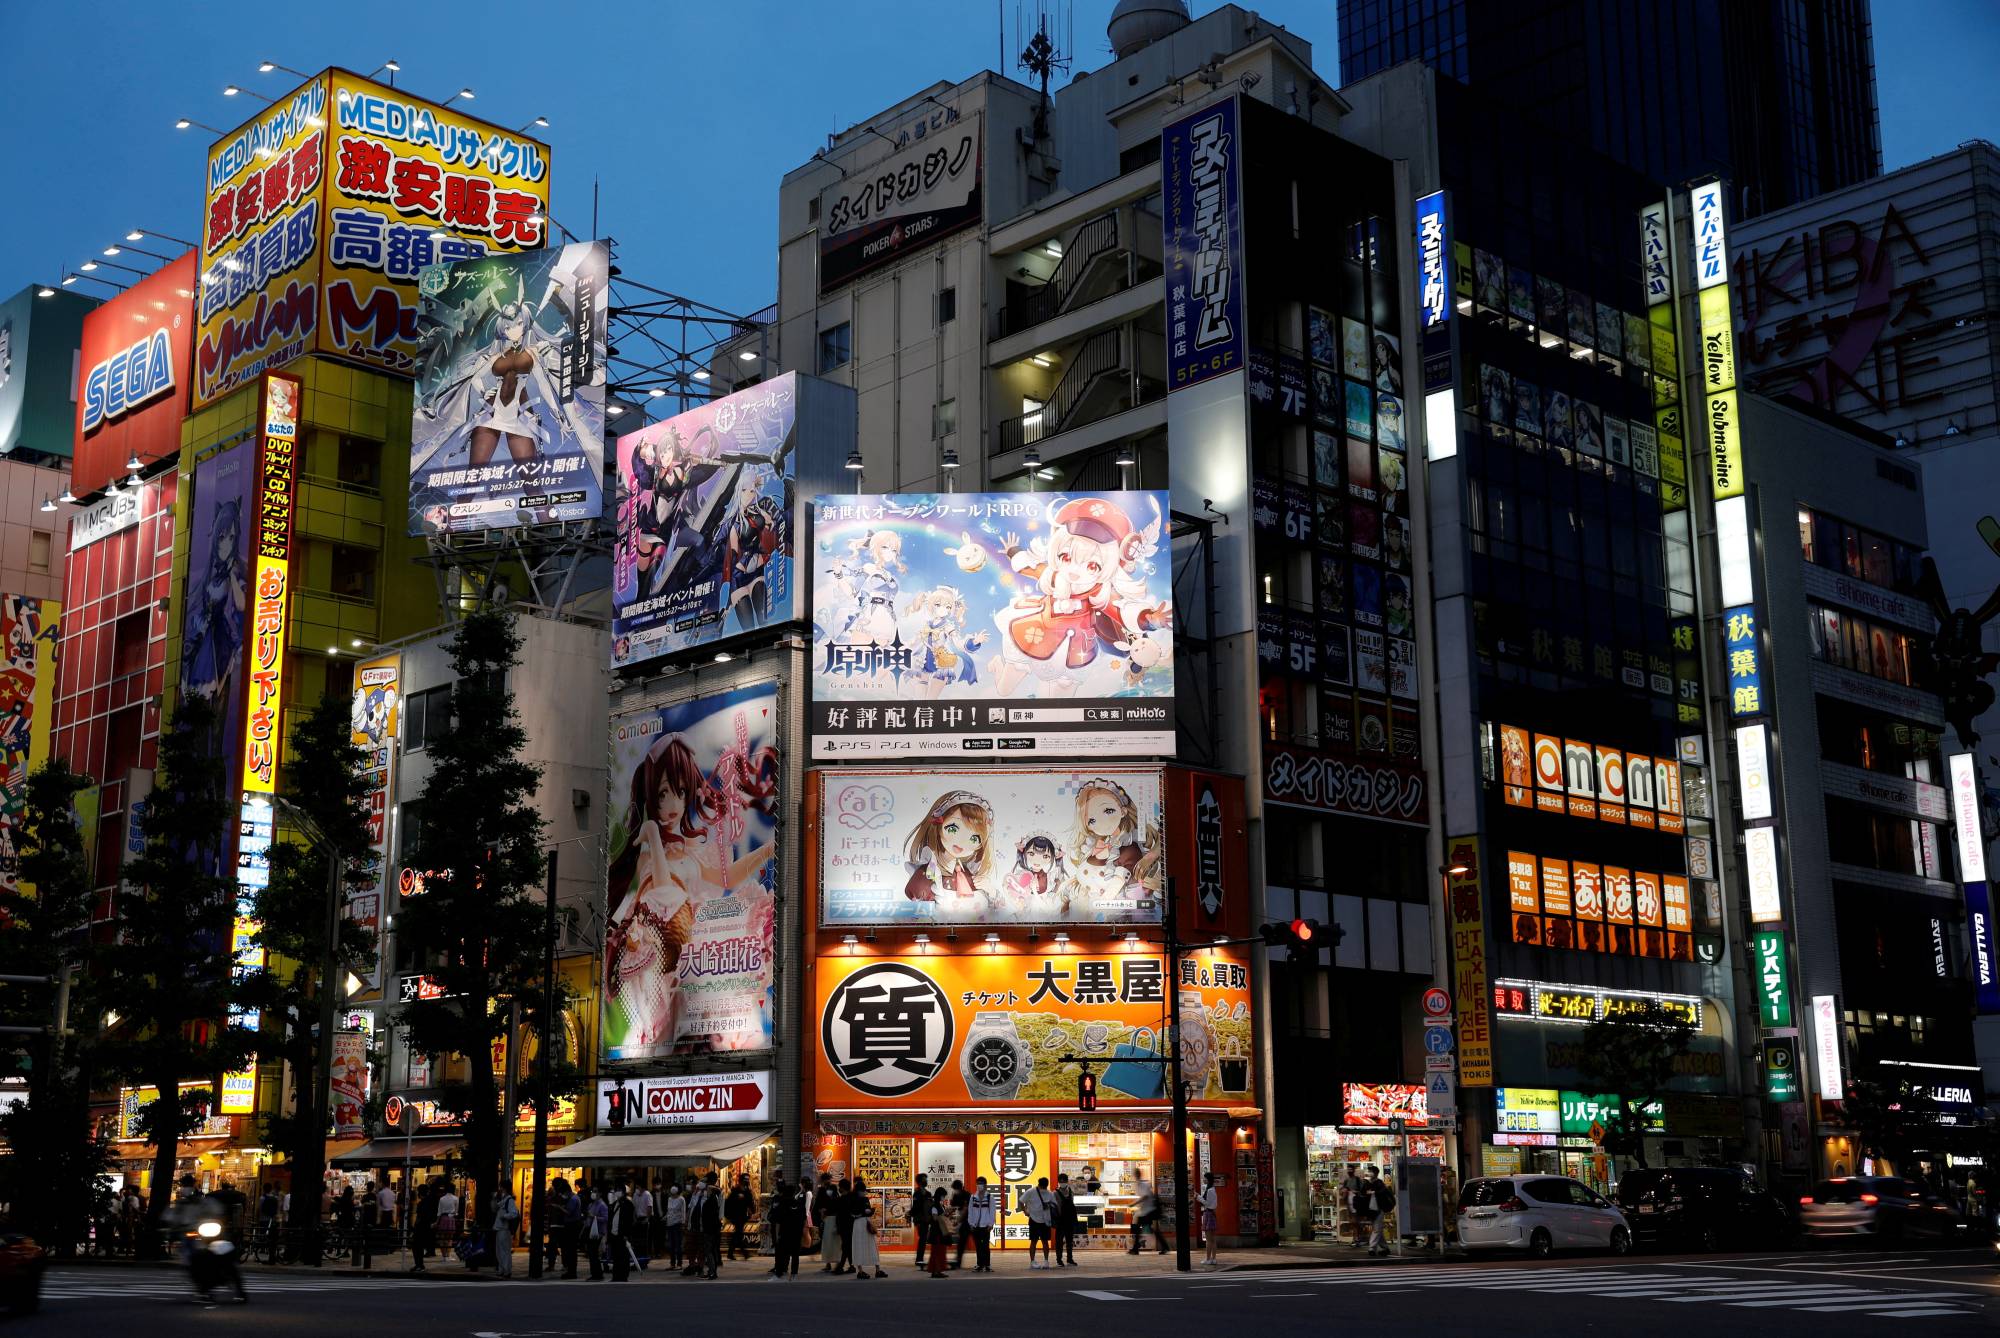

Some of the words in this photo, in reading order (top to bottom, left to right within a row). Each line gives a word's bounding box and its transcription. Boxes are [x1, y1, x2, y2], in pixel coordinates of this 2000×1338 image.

[209, 84, 325, 194] MEDIAリサイクル
[340, 94, 541, 182] MEDIAリサイクル
[207, 133, 321, 248] 激安販売
[340, 139, 538, 242] 激安販売
[830, 136, 972, 234] メイドカジノ
[863, 237, 891, 258] POKER
[1699, 192, 1721, 279] スーパービル
[201, 203, 317, 321] 高額買取
[577, 289, 592, 378] ニュージャージー
[1173, 286, 1187, 358] 秋葉原店
[198, 284, 316, 397] Mulan
[562, 343, 573, 352] CV
[348, 342, 415, 371] ムーラン
[1177, 350, 1234, 383] 5F・6F
[1706, 333, 1725, 386] Yellow
[83, 327, 176, 433] SEGA
[206, 372, 242, 399] ムーラン
[241, 358, 265, 383] AKIBA
[1280, 385, 1307, 416] 7F
[268, 423, 294, 435] あなたの
[267, 440, 292, 453] DVD
[1711, 399, 1730, 489] Submarine
[265, 452, 291, 466] ブルーレイ
[264, 465, 290, 480] ゲーム
[427, 456, 587, 488] 期間限定海域イベント開催!
[268, 479, 286, 491] CD
[263, 491, 288, 506] アイドル
[452, 504, 483, 515] アズレン
[87, 499, 137, 530] MC-UBS
[261, 504, 288, 519] アニメ
[261, 517, 286, 531] コミック
[558, 506, 587, 517] Yostar
[822, 503, 1038, 520] 新世代オープンワールドRPG
[261, 531, 285, 543] ホビー
[1284, 511, 1313, 542] 6F
[260, 544, 285, 558] フィギュア
[632, 632, 652, 643] アズレン
[822, 628, 913, 695] 原神
[1288, 641, 1318, 673] 5F
[1532, 625, 1617, 681] 秋葉館
[1622, 648, 1644, 667] 中古
[1728, 613, 1760, 715] 秋葉館
[829, 681, 884, 690] Genshin
[1680, 679, 1699, 699] 5F
[828, 706, 978, 729] 好評配信中!
[1013, 711, 1034, 720] 原神
[1100, 710, 1120, 720] 検索
[1126, 708, 1166, 719] miHoYo
[617, 716, 664, 741] amiami
[840, 741, 871, 750] PS5
[880, 741, 911, 750] PS4
[919, 740, 958, 750] Windows
[1268, 751, 1423, 818] メイドカジノ
[1535, 740, 1670, 808] amiami
[720, 753, 744, 841] アイドル
[128, 801, 149, 853] SEGA
[240, 823, 253, 836] 5F
[841, 836, 891, 850] バーチャル
[1967, 839, 1979, 867] cafe
[238, 853, 251, 866] 4F
[852, 871, 881, 883] カフェ
[1451, 844, 1481, 923] 免税
[1513, 876, 1531, 891] Tax
[1511, 892, 1534, 907] Free
[1573, 870, 1659, 924] あみあみ
[680, 936, 762, 978] 大崎甜花
[1469, 929, 1482, 975] TAX
[1973, 912, 1991, 986] GALLERIA
[231, 965, 244, 977] 1F
[1026, 959, 1165, 1006] 大黒屋
[1179, 958, 1247, 990] 質&買取
[1760, 938, 1783, 1021] リバティー
[962, 990, 1019, 1006] チケット
[1455, 930, 1475, 1042] 면세점
[1429, 996, 1445, 1009] 40
[1473, 983, 1488, 1042] FREE
[1494, 988, 1524, 1012] 買取
[838, 981, 942, 1080] 質
[1672, 1053, 1723, 1078] AKB48
[224, 1078, 252, 1091] AKIBA
[647, 1078, 673, 1086] Professional
[673, 1077, 690, 1086] Support
[698, 1075, 721, 1084] Magazine
[1787, 1084, 1797, 1093] IN
[648, 1087, 705, 1112] COMIC
[708, 1087, 734, 1109] ZIN
[1562, 1101, 1620, 1121] リバティー
[646, 1114, 694, 1125] Akihabara
[822, 1119, 872, 1133] 高価買取
[1052, 1119, 1090, 1131] 電化製品
[927, 1163, 956, 1175] 大黒屋
[996, 1142, 1032, 1178] 質
[1950, 1155, 1981, 1166] GALLERIA
